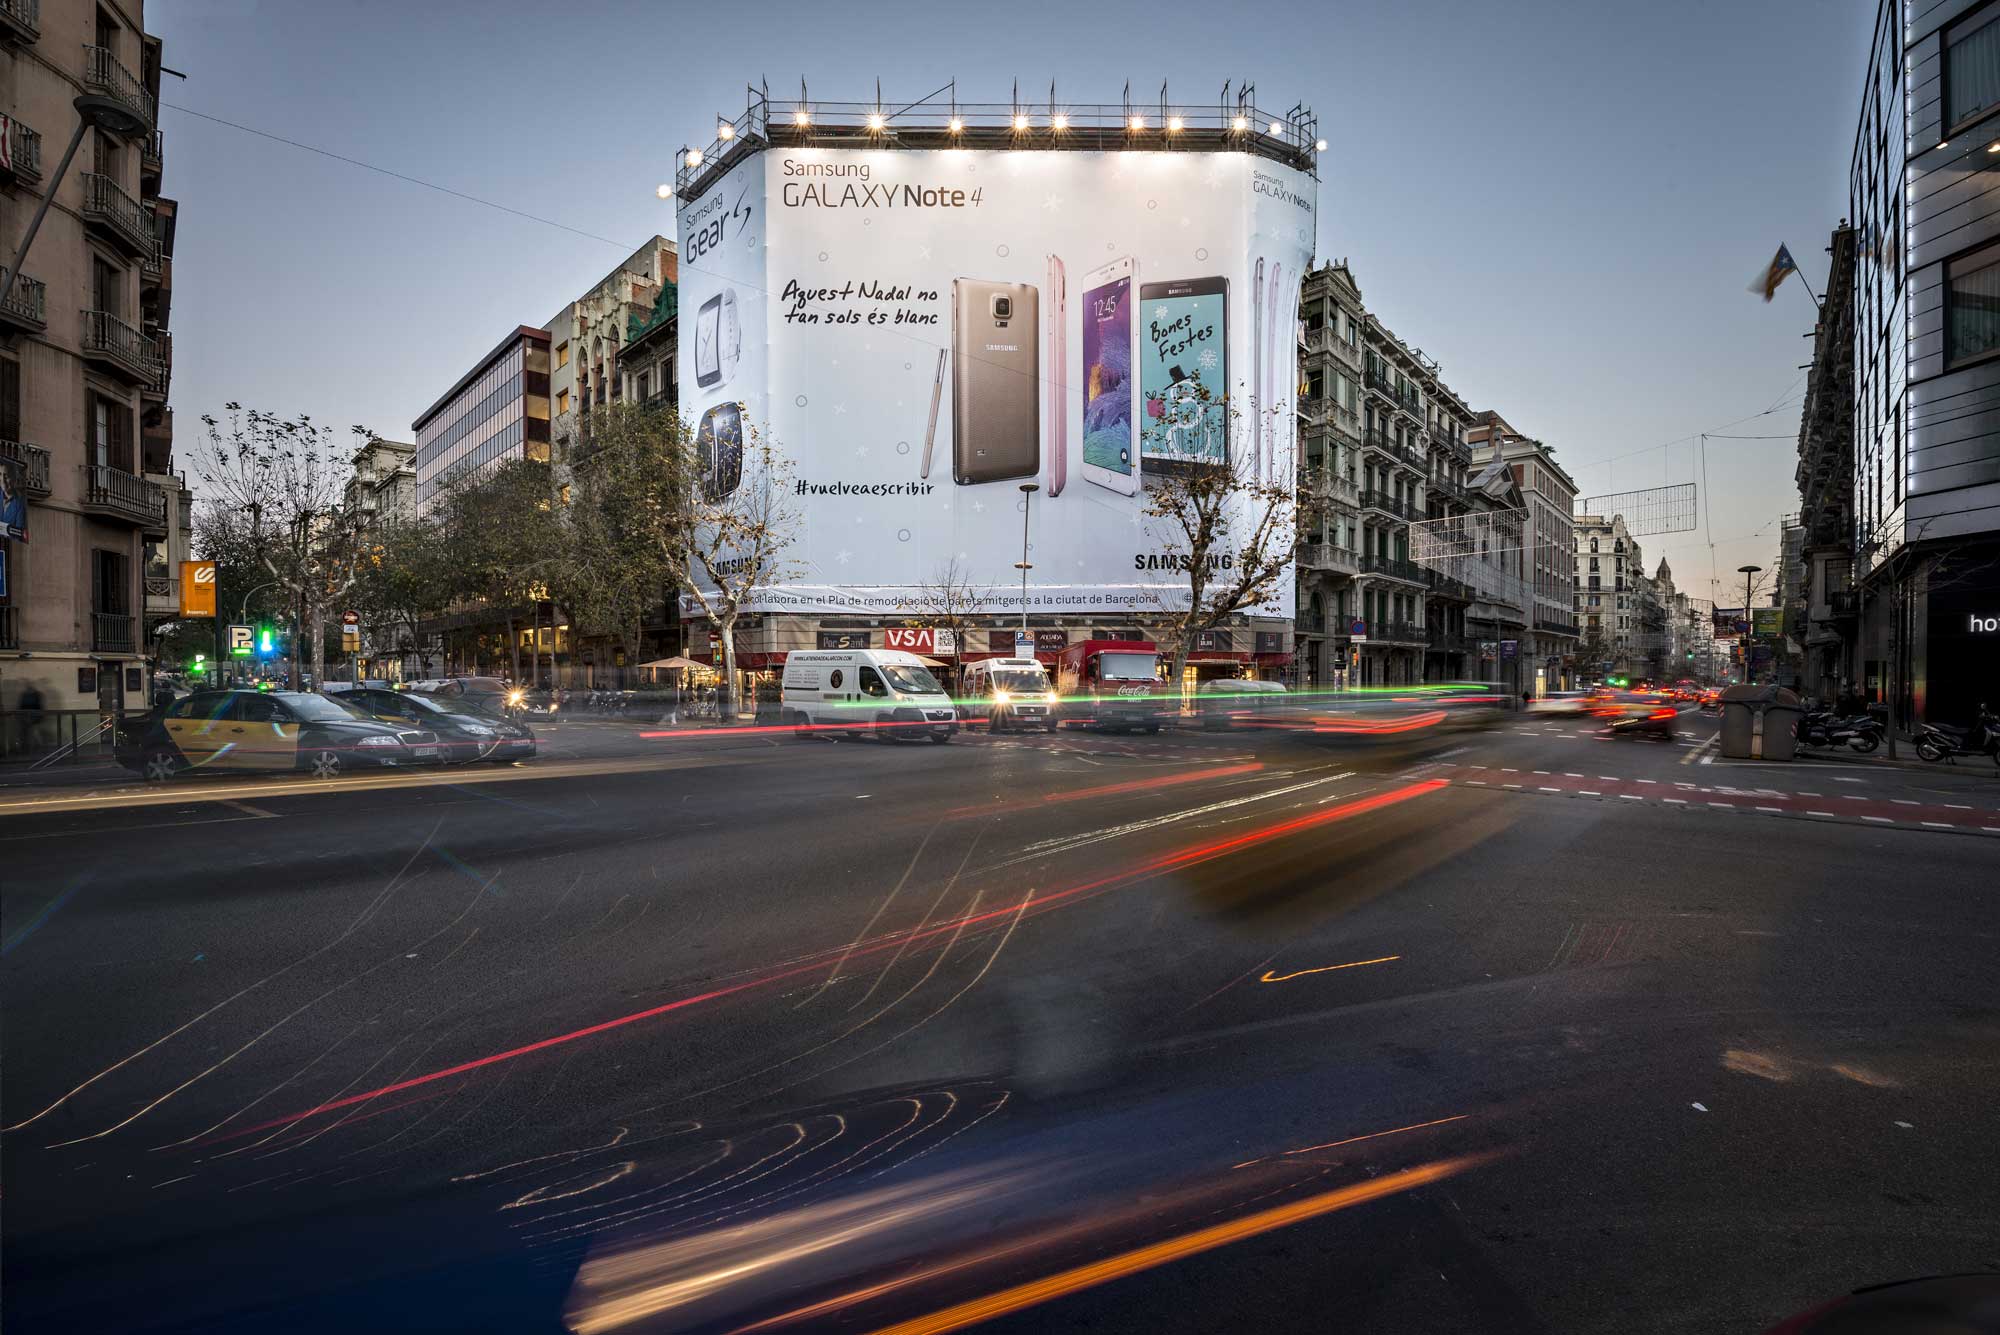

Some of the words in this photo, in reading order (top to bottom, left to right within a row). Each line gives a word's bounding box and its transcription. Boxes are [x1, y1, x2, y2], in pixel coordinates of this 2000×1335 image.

[783, 159, 870, 181] Samsung
[1253, 170, 1284, 188] Samsung
[783, 183, 899, 208] GALAXY
[904, 184, 966, 207] Note
[970, 186, 984, 208] 4
[1253, 181, 1293, 203] GALAXY
[686, 192, 723, 230] Samsung
[686, 211, 730, 265] Gear
[781, 279, 854, 309] Aquest
[858, 280, 912, 301] Nadal
[917, 292, 938, 301] no
[784, 303, 819, 324] tan
[824, 309, 862, 324] sols
[867, 307, 888, 325] és
[894, 308, 938, 325] blanc
[1093, 295, 1116, 317] 12:45
[1150, 314, 1192, 343] Bones
[1159, 325, 1213, 363] Festes
[794, 479, 935, 497] #vuelveaescribir
[1135, 554, 1232, 570] SAMSNG
[800, 596, 813, 604] en
[816, 595, 826, 604] el
[828, 595, 845, 605] Pla
[848, 596, 861, 605] de
[864, 595, 930, 606] remodelació
[932, 596, 946, 606] de
[949, 596, 982, 608] parets
[985, 595, 1032, 609] mitgeres
[1043, 595, 1053, 604] la
[1055, 595, 1087, 604] ciutat
[1089, 594, 1103, 604] de
[1105, 594, 1158, 604] Barcelona
[1970, 614, 2000, 632] ho
[231, 628, 253, 648] P
[887, 629, 932, 647] VSA
[1017, 632, 1024, 640] P
